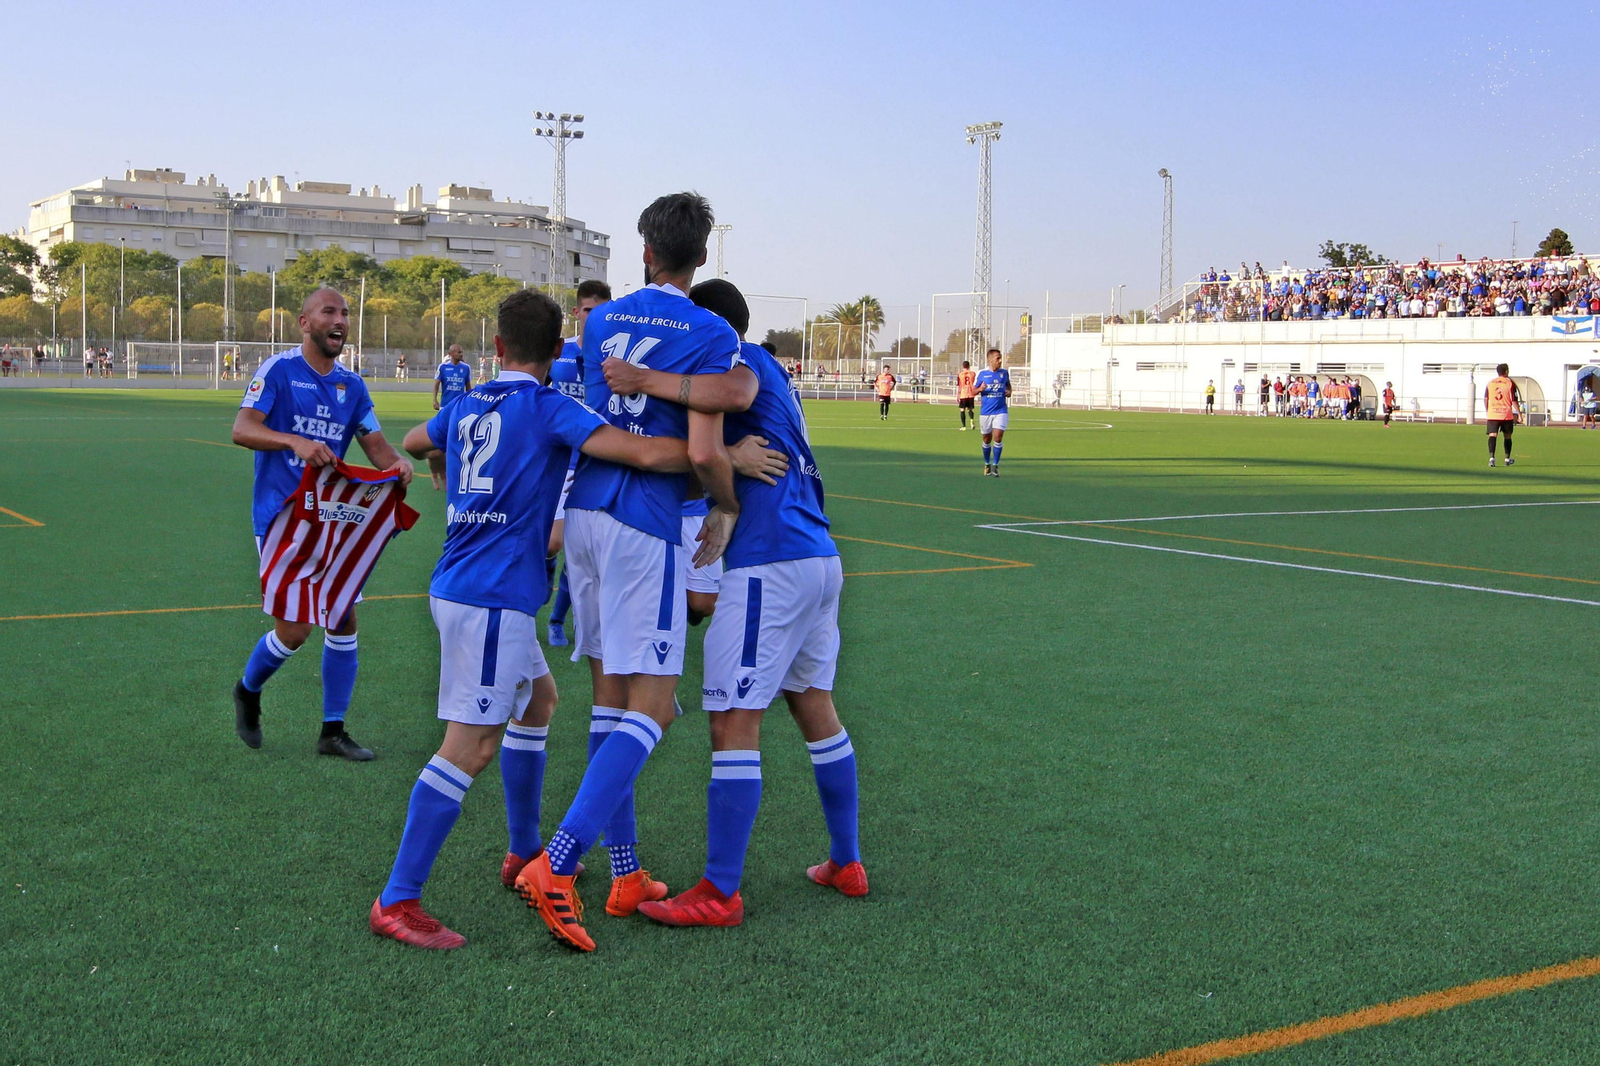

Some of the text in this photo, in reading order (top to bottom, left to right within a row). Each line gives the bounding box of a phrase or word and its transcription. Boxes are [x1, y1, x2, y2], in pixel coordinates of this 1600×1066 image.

[651, 317, 690, 331] ERCILLA
[291, 380, 318, 390] macron
[965, 376, 971, 385] 8
[558, 381, 585, 396] XER
[1494, 386, 1504, 401] 3
[316, 404, 331, 418] EL
[291, 414, 345, 441] XEREZ
[457, 411, 501, 494] 12
[702, 687, 728, 698] acron
